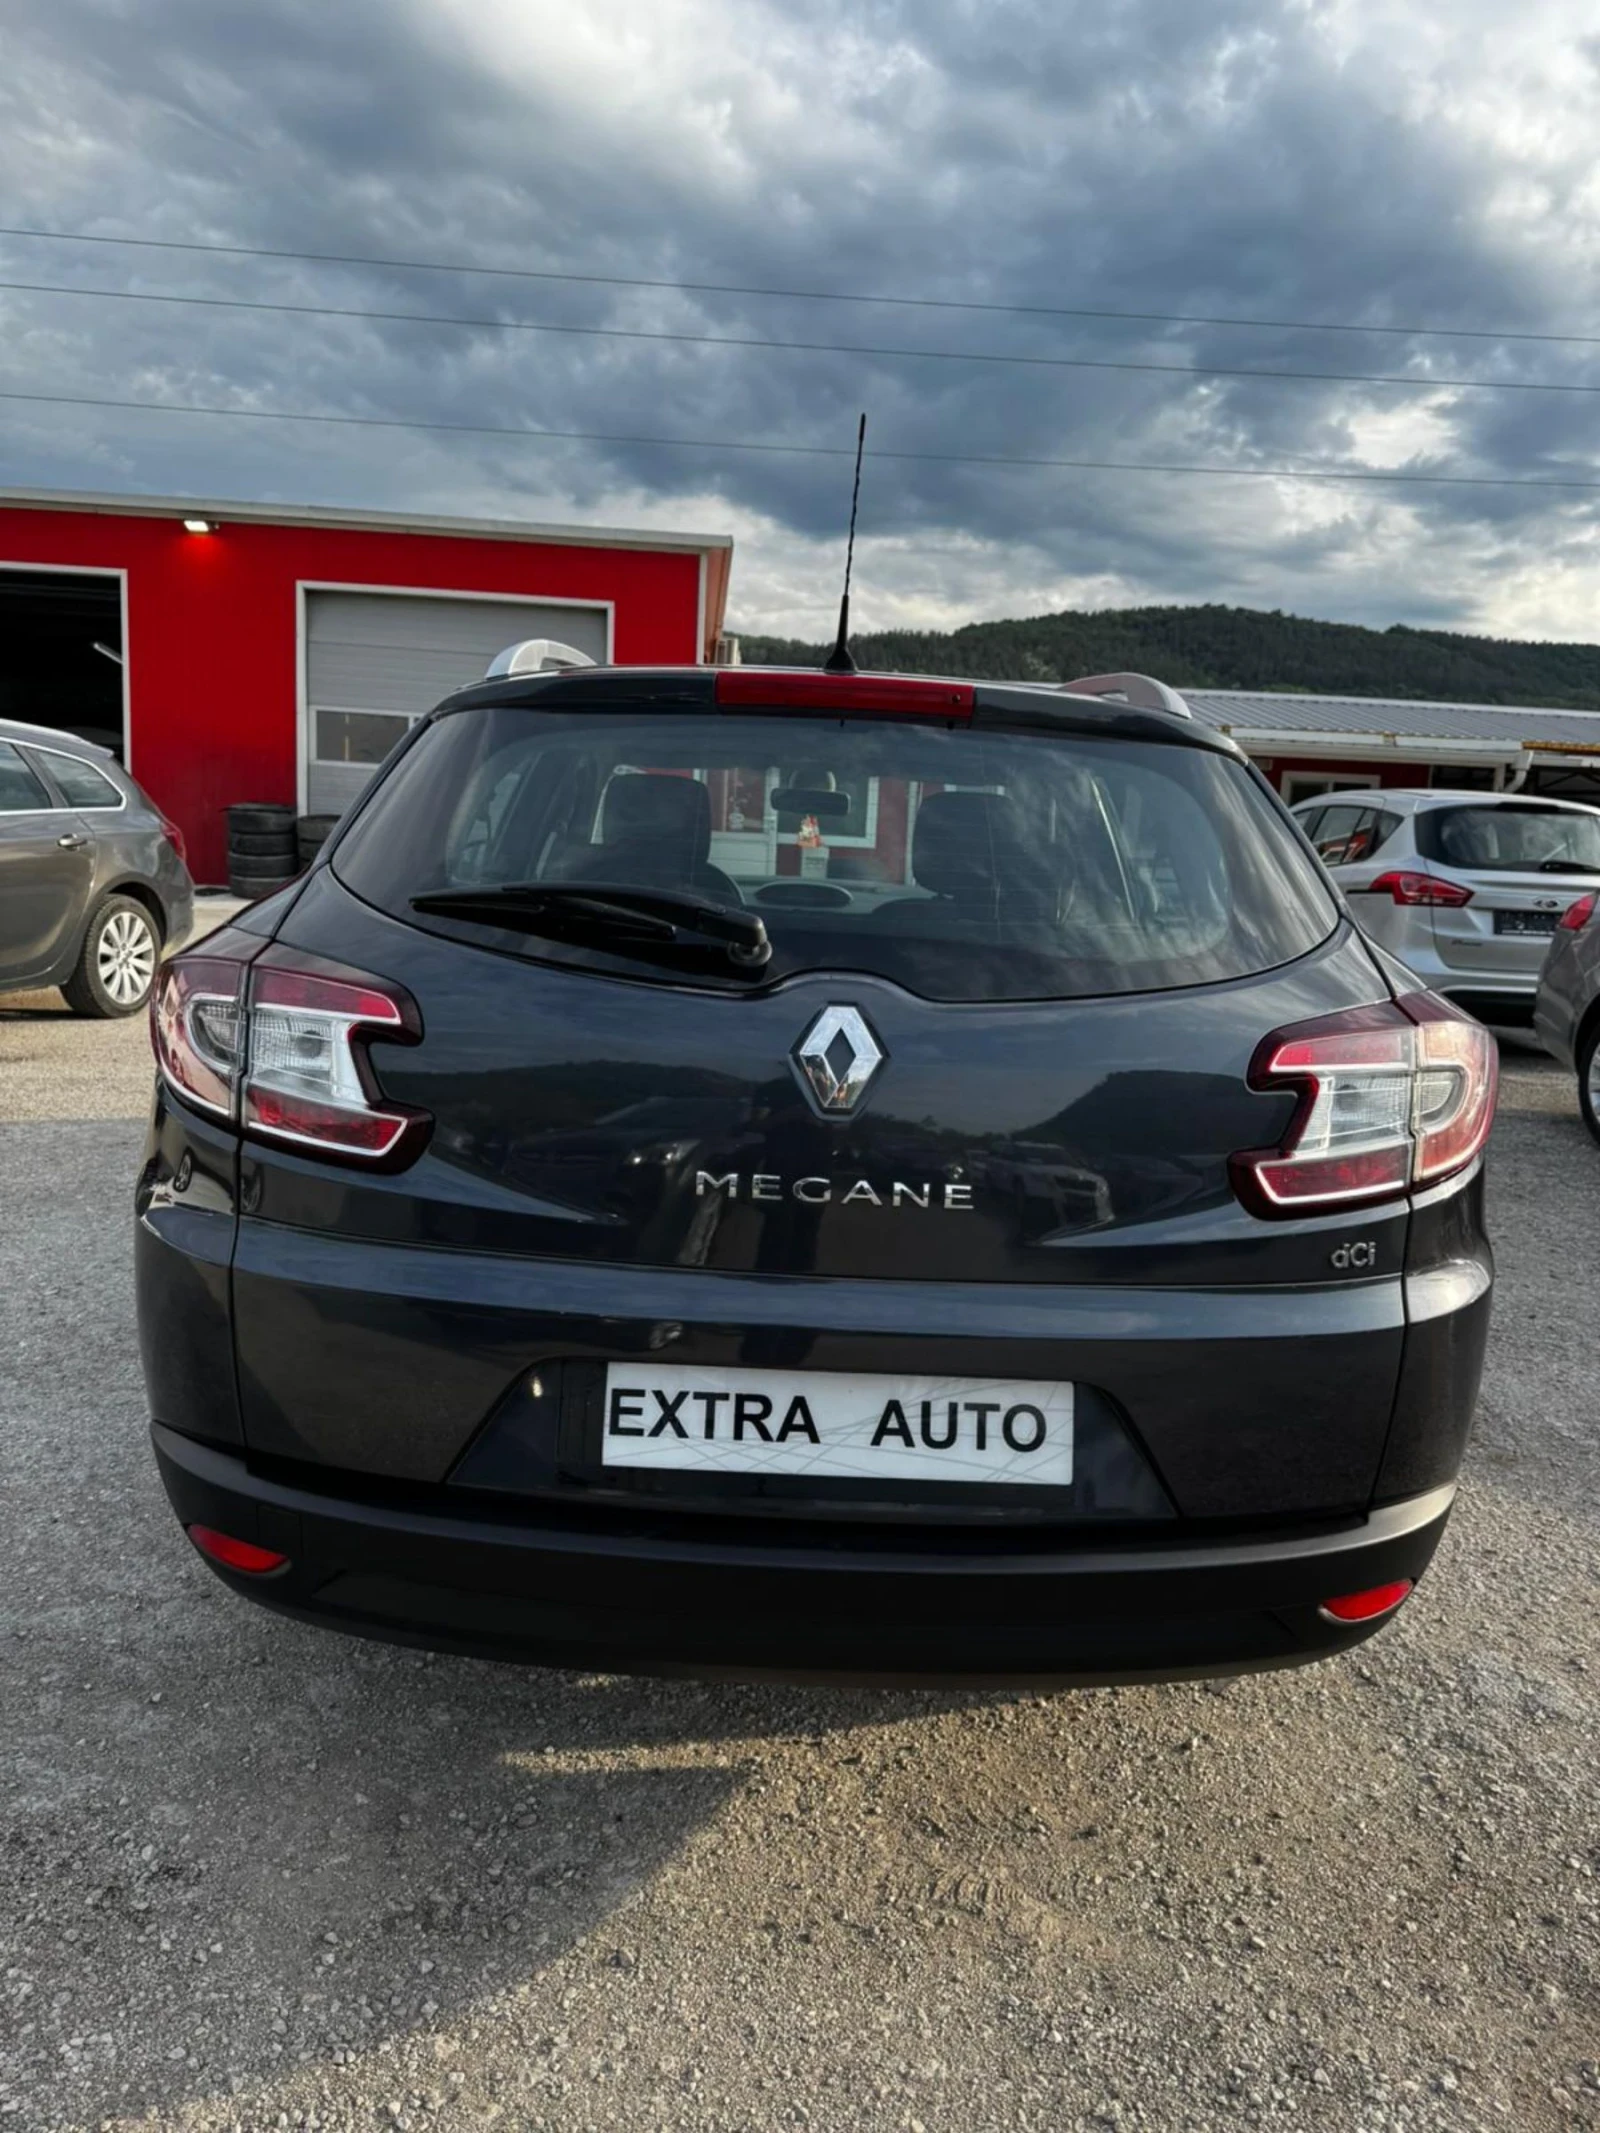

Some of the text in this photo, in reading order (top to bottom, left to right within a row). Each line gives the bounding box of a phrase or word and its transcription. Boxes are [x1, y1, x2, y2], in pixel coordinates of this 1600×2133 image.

[696, 1171, 975, 1210] MEGANE
[1330, 1241, 1377, 1269] dCi
[607, 1387, 1047, 1453] EXTRA AUTO
